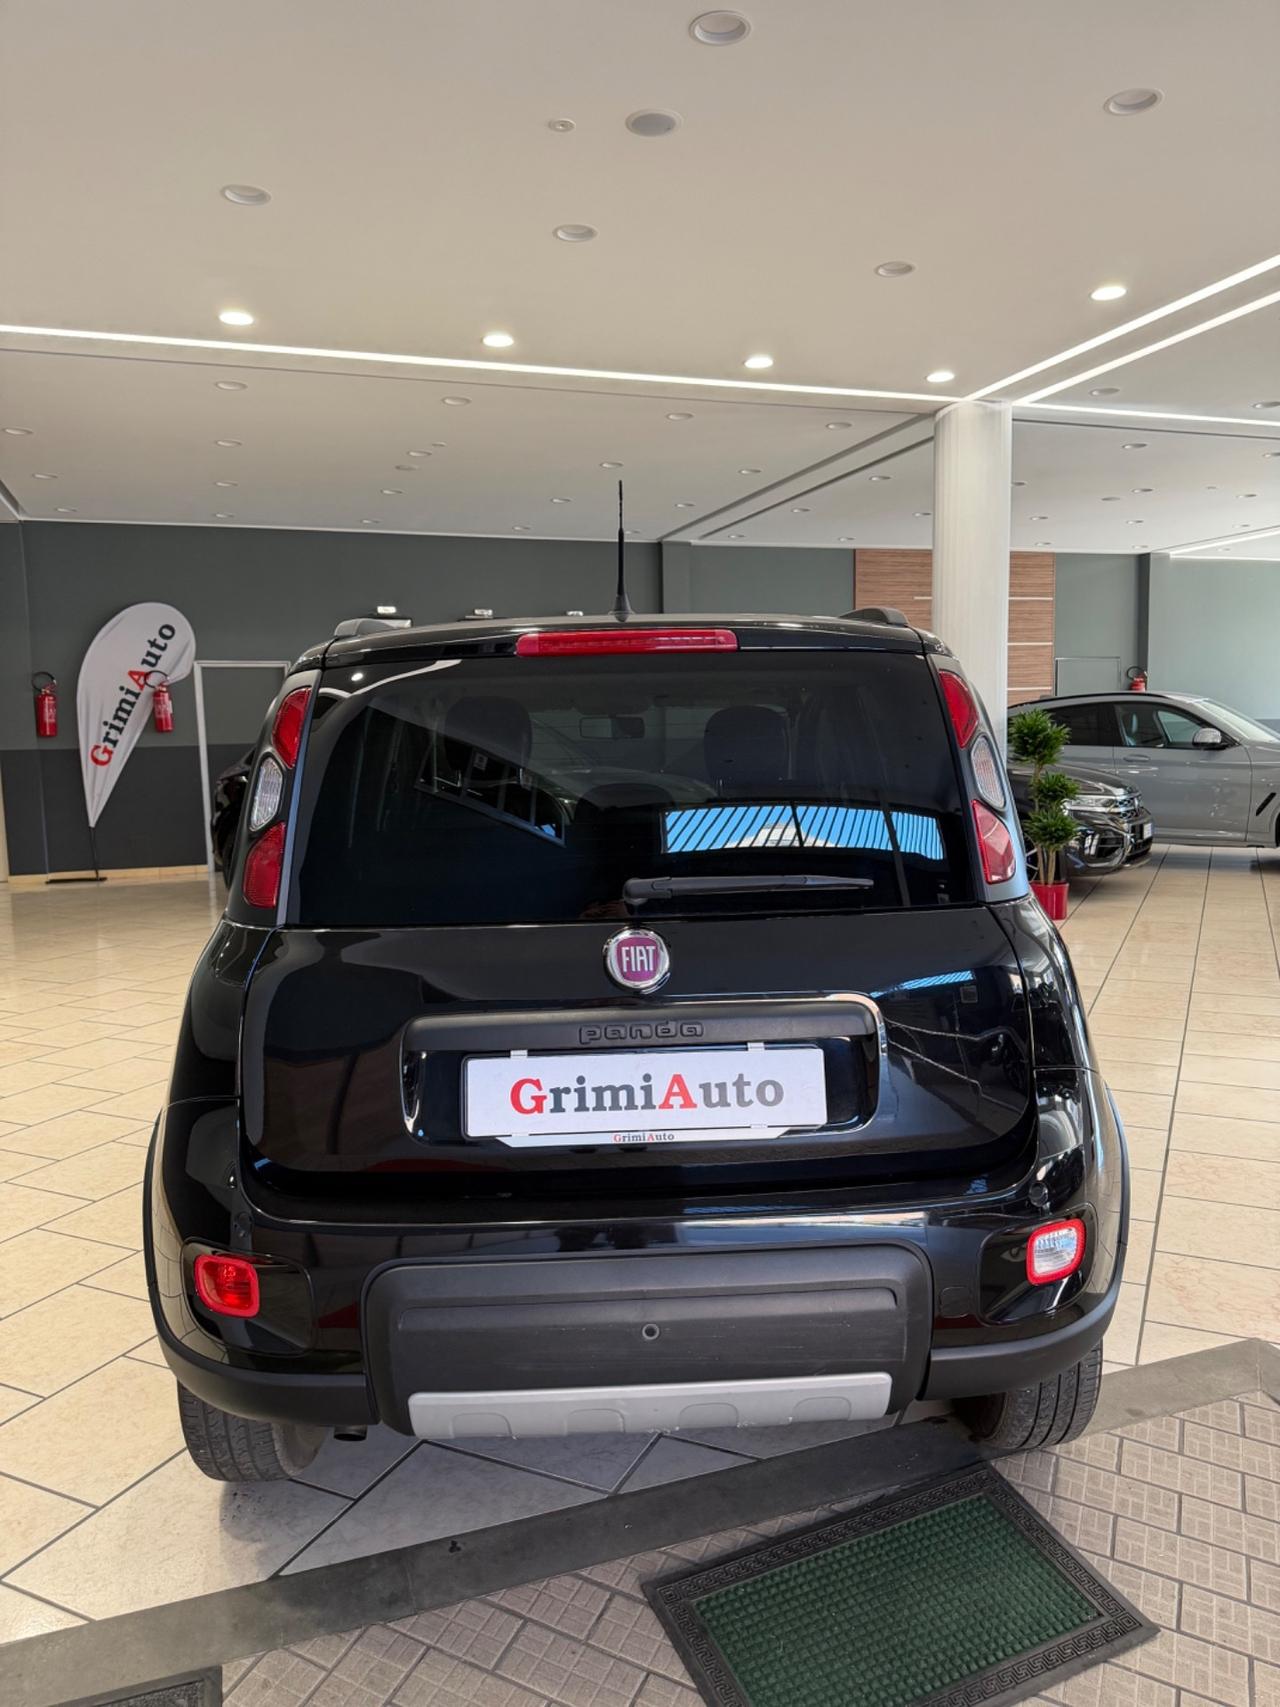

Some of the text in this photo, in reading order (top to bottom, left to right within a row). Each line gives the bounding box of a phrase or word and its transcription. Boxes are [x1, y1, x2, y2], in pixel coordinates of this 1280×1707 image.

[91, 623, 176, 767] GrimiAuto
[621, 945, 656, 973] FIAT
[578, 1020, 704, 1045] panda
[510, 1073, 784, 1115] GrimiAuto
[613, 1132, 675, 1143] GrimiAuto
